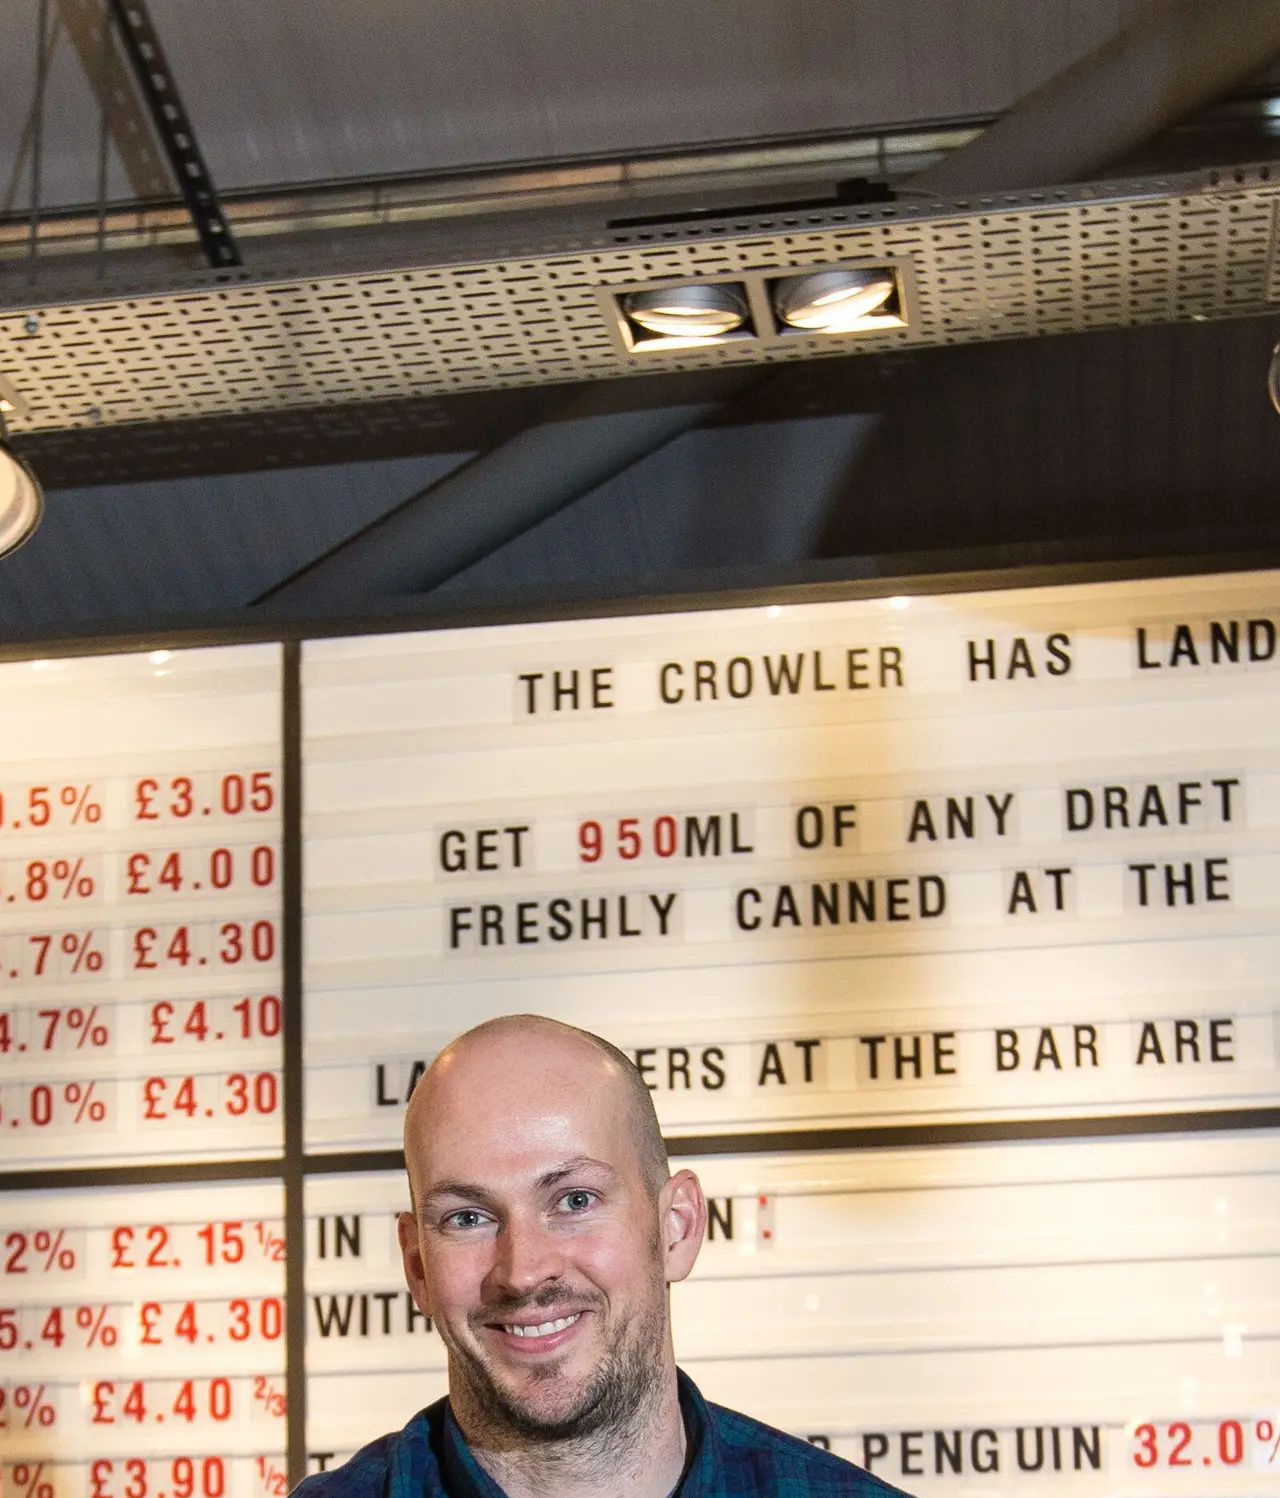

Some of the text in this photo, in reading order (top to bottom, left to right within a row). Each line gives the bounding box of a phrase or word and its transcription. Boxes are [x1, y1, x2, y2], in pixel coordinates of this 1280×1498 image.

[519, 667, 615, 715] THE
[658, 645, 905, 705] CROWLER
[968, 632, 1073, 682] HAS
[135, 772, 274, 820] £3.05
[439, 826, 530, 873] GET
[578, 812, 754, 863] 950ML
[795, 804, 857, 851] OF
[907, 793, 1015, 843] ANY
[1065, 779, 1240, 832] DRAFT
[126, 846, 275, 895] £4.00
[449, 893, 677, 950] FRESHLY
[735, 875, 947, 931] CANNED
[1007, 870, 1072, 916] AT
[1129, 857, 1230, 908] THE
[132, 920, 275, 969] £4.30
[149, 995, 281, 1044] £4.10
[757, 1039, 821, 1086] AT
[860, 1031, 956, 1081] THE
[995, 1024, 1099, 1072] BAR
[1136, 1018, 1235, 1066] ARE
[143, 1071, 277, 1119] £4.30
[318, 1215, 360, 1258] IN
[139, 1297, 283, 1346] £4.30
[313, 1292, 432, 1337] WITH
[91, 1376, 232, 1425] £4.40
[862, 1426, 1101, 1476] PENGUIN
